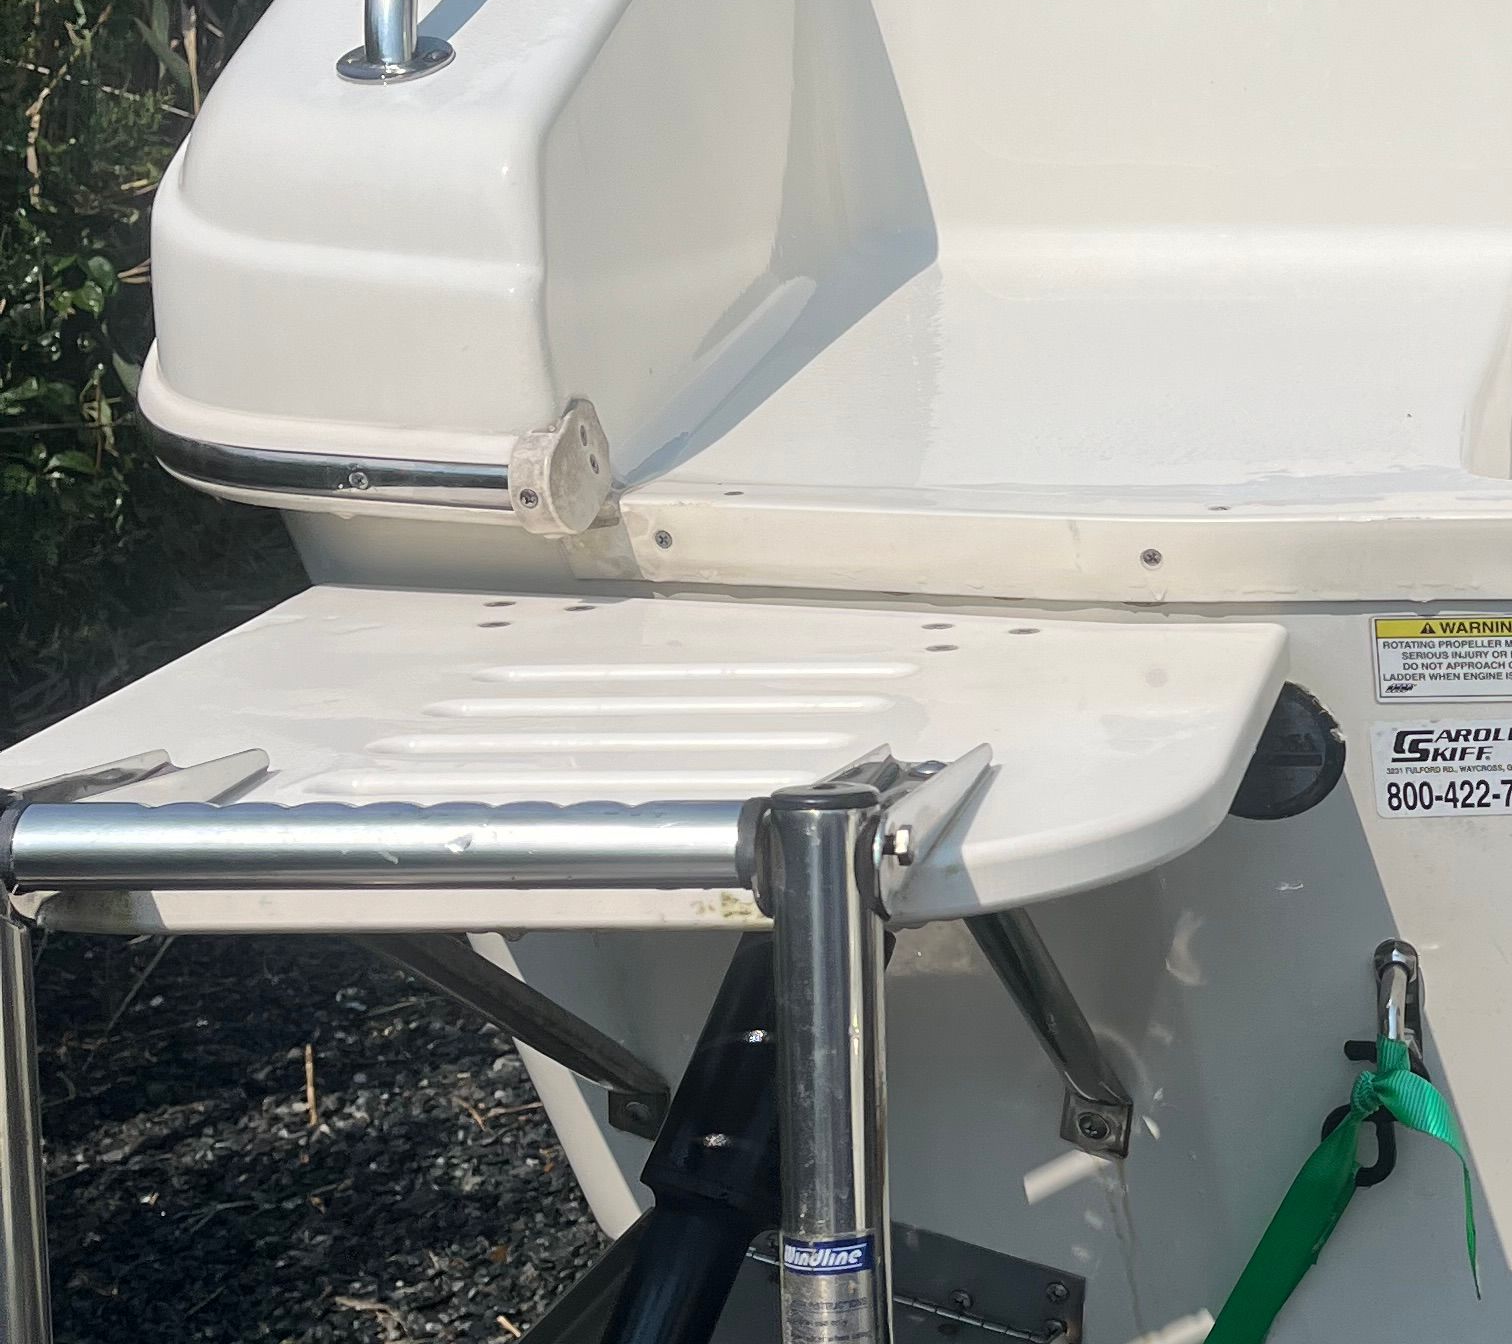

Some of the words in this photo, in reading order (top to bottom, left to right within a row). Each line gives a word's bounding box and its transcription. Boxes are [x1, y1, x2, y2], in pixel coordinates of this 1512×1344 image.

[1382, 640, 1435, 649] ROTATING
[1438, 639, 1502, 649] PROPELLER
[1401, 651, 1449, 660] SERIOUS
[1451, 650, 1489, 659] INJURY
[1492, 650, 1507, 659] OR
[1402, 662, 1419, 671] DO
[1421, 662, 1443, 670] NOT
[1445, 661, 1506, 670] APPROACH
[1382, 673, 1426, 681] LADDER
[1428, 672, 1460, 681] WHEN
[1463, 671, 1503, 680] ENGINE
[1391, 738, 1493, 763] SKIFF
[784, 1244, 863, 1267] Windline
